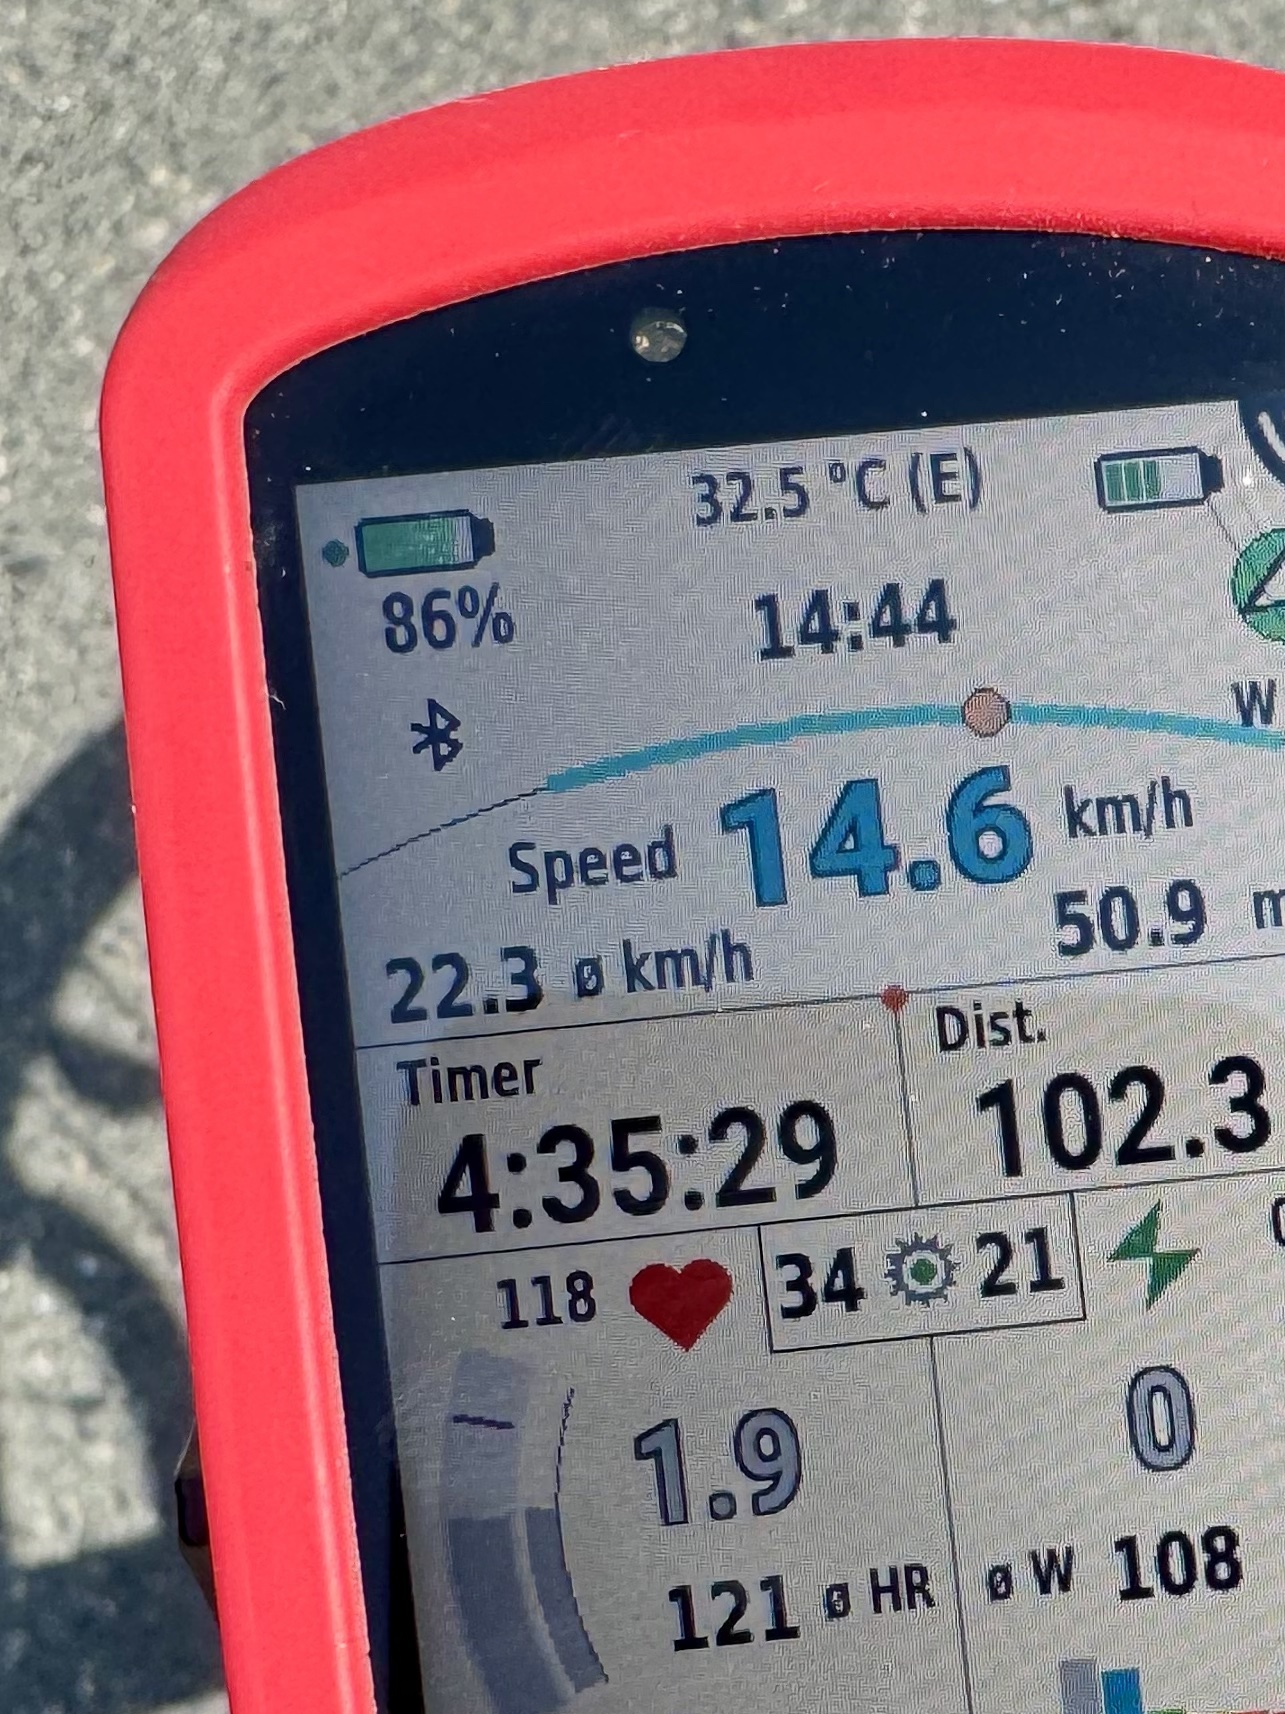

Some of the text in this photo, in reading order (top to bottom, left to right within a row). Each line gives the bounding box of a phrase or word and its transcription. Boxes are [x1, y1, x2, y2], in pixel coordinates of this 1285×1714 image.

[692, 466, 810, 527] 32.5
[909, 447, 982, 517] (E)
[382, 582, 516, 654] 86%
[755, 578, 957, 661] 14:44
[1231, 679, 1276, 729] W
[509, 765, 1193, 911] Speed 14.6 km/h
[1053, 879, 1207, 960] 50.9
[385, 946, 544, 1024] 22.3
[623, 929, 754, 993] km/h
[936, 1000, 1046, 1054] Dist.
[397, 1057, 542, 1107] Timer
[974, 1054, 1270, 1177] 102.3
[435, 1099, 839, 1235] 4:35:29
[497, 1270, 596, 1329] 118
[776, 1225, 1065, 1319] 34 21
[1125, 1364, 1198, 1473] 0
[634, 1408, 802, 1526] 1.9
[1028, 1546, 1074, 1595] W
[1114, 1525, 1243, 1603] 108
[669, 1575, 800, 1652] 121
[870, 1563, 935, 1614] HR
